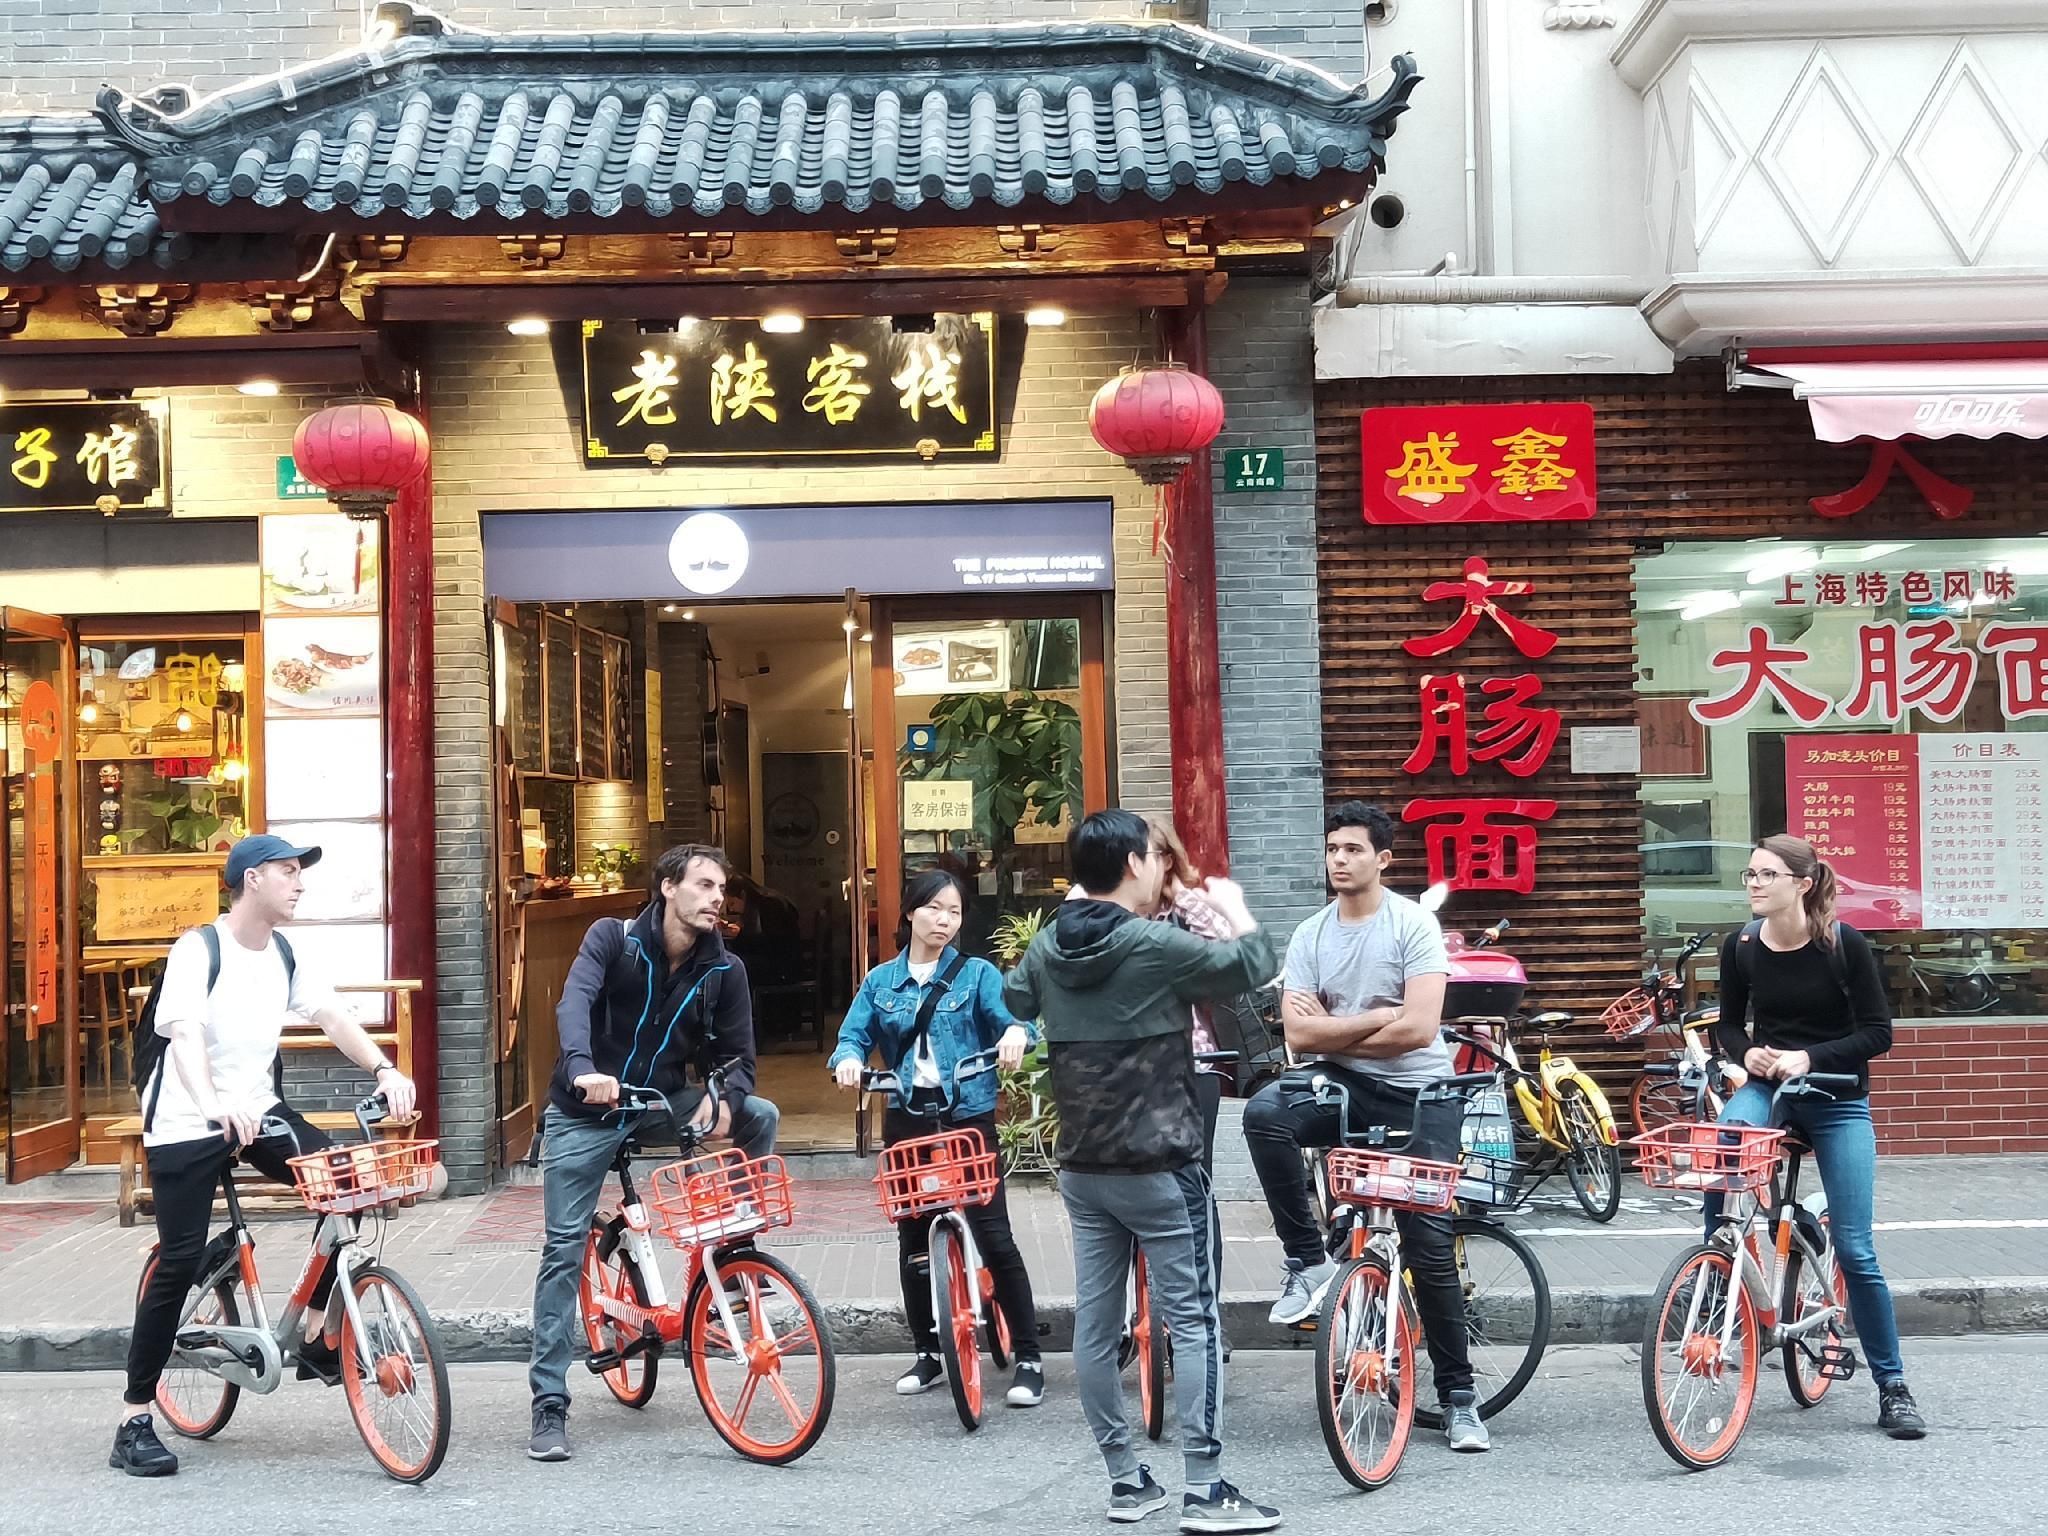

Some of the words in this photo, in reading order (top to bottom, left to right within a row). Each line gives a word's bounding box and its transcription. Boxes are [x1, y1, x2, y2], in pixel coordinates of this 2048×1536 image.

[612, 342, 968, 427] 老陕客栈
[1914, 398, 2031, 430] 可口可乐
[1241, 453, 1268, 475] 17
[953, 558, 981, 571] THE
[1773, 570, 2017, 607] 上海特色风味
[1402, 556, 1561, 894] 大肠面
[1951, 743, 2020, 757] 价目表
[1929, 769, 1993, 779] 美味大肠面
[2015, 769, 2040, 778] 25元
[1803, 782, 1829, 792] 大肠
[1883, 783, 1907, 792] 19元
[1883, 795, 1907, 805] 19元
[911, 801, 969, 818] 客房保洁
[1883, 808, 1908, 817] 19元
[1888, 821, 1908, 831] 8元
[1888, 834, 1909, 843] 8元
[1884, 847, 1909, 856] 10元
[1460, 1126, 1509, 1143] 飞车行
